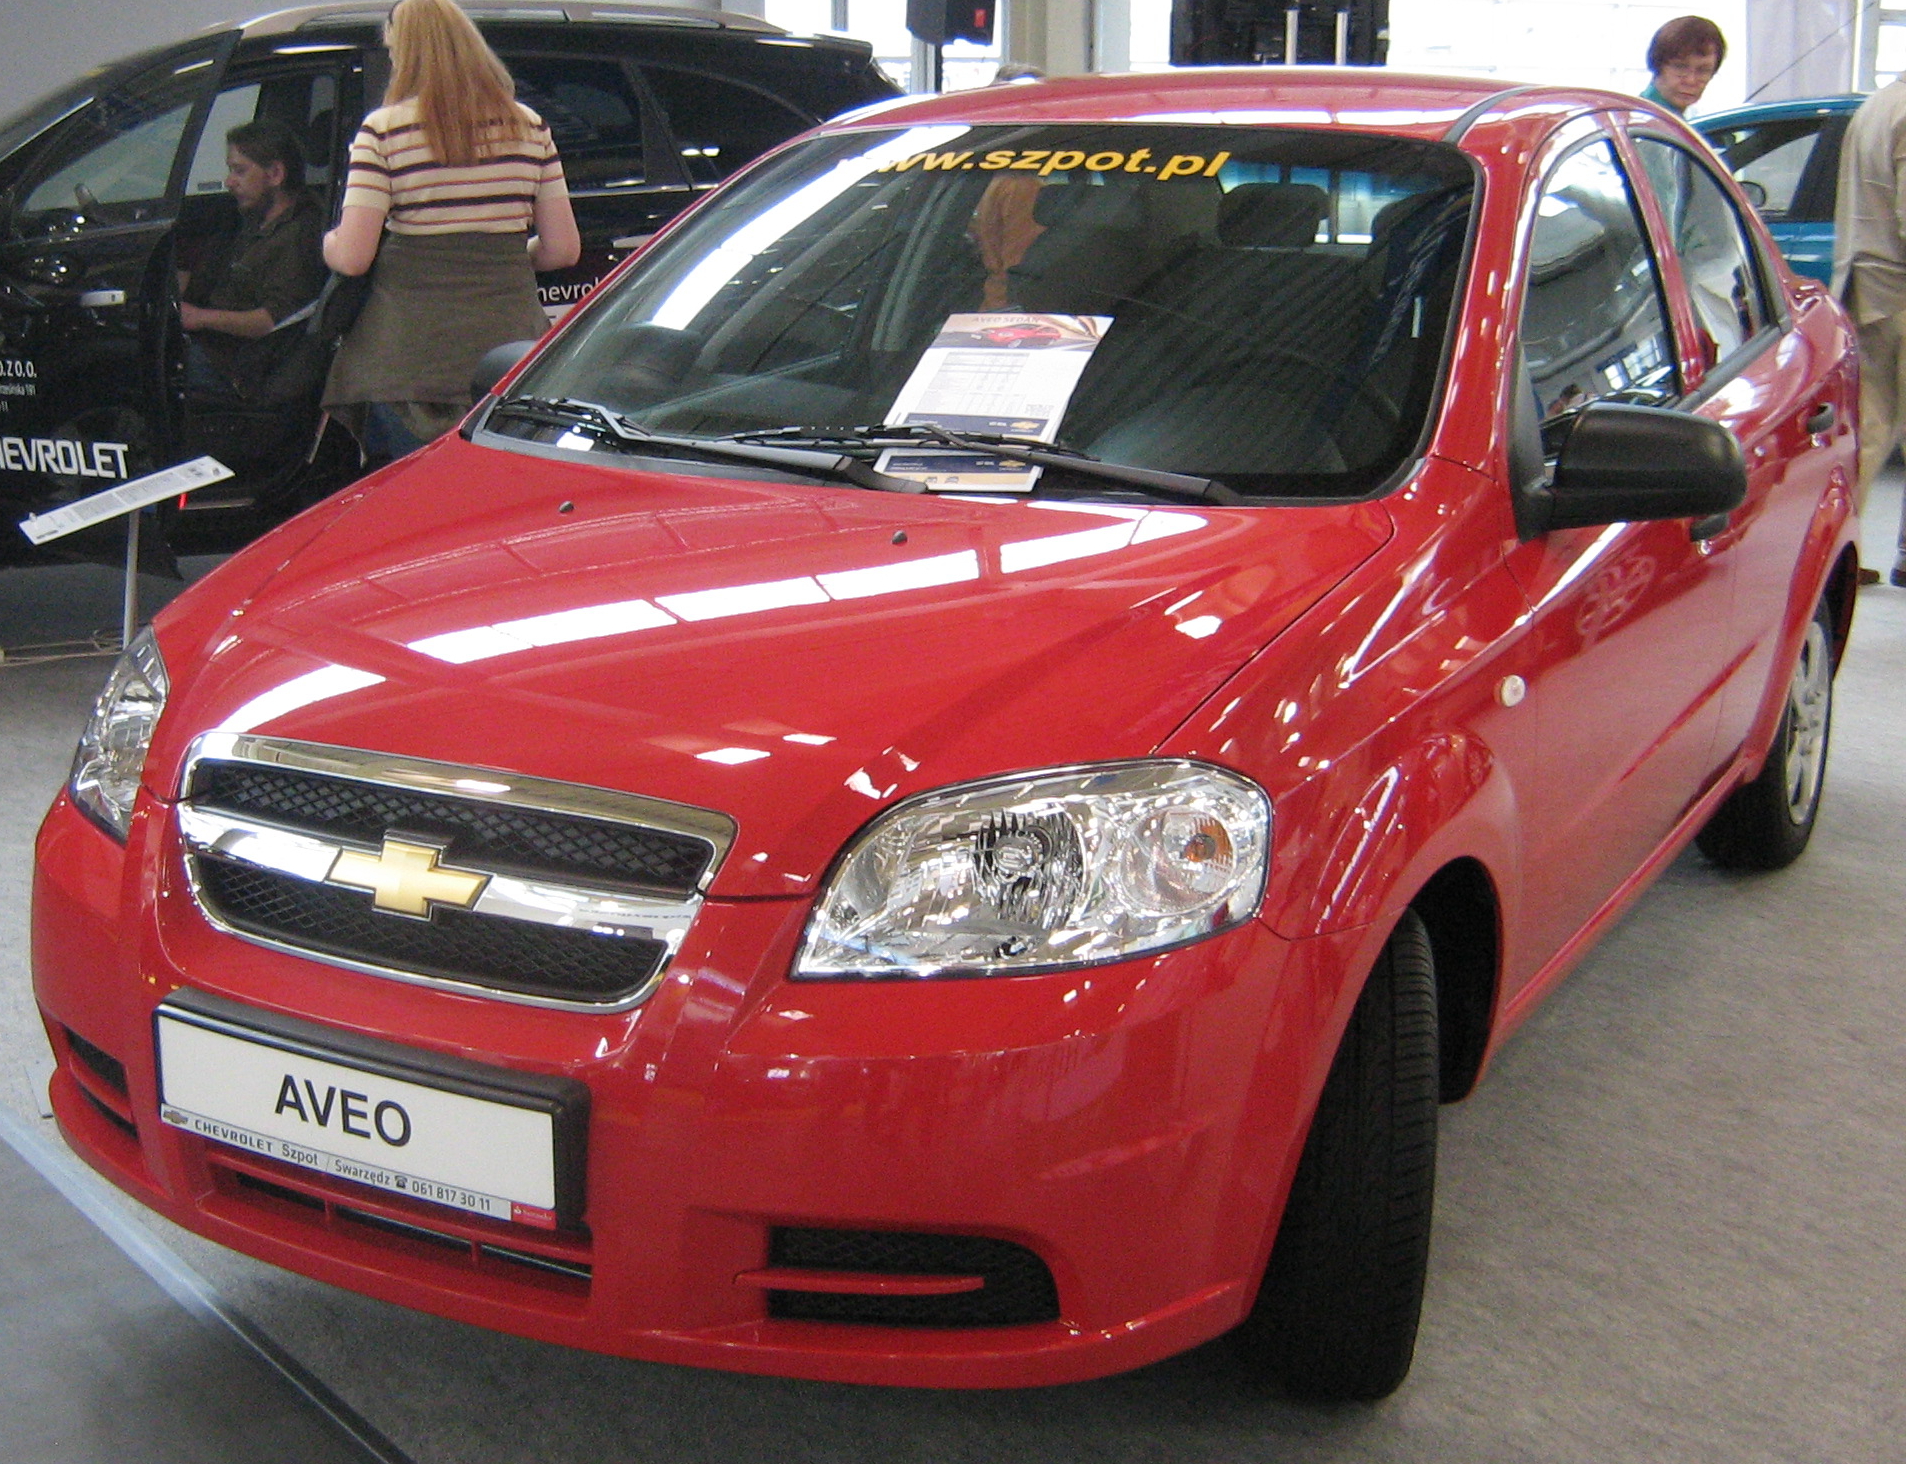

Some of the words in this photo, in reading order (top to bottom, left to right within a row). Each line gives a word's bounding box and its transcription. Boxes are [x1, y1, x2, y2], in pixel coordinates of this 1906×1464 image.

[840, 148, 1231, 181] ww.szpot.pl
[274, 1073, 412, 1148] AVEO
[194, 1118, 273, 1153] CHEVROLET
[282, 1143, 319, 1170] Szpot
[412, 1180, 434, 1197] 061
[436, 1189, 457, 1203] 817
[460, 1192, 476, 1207] 30
[479, 1197, 491, 1211] 11
